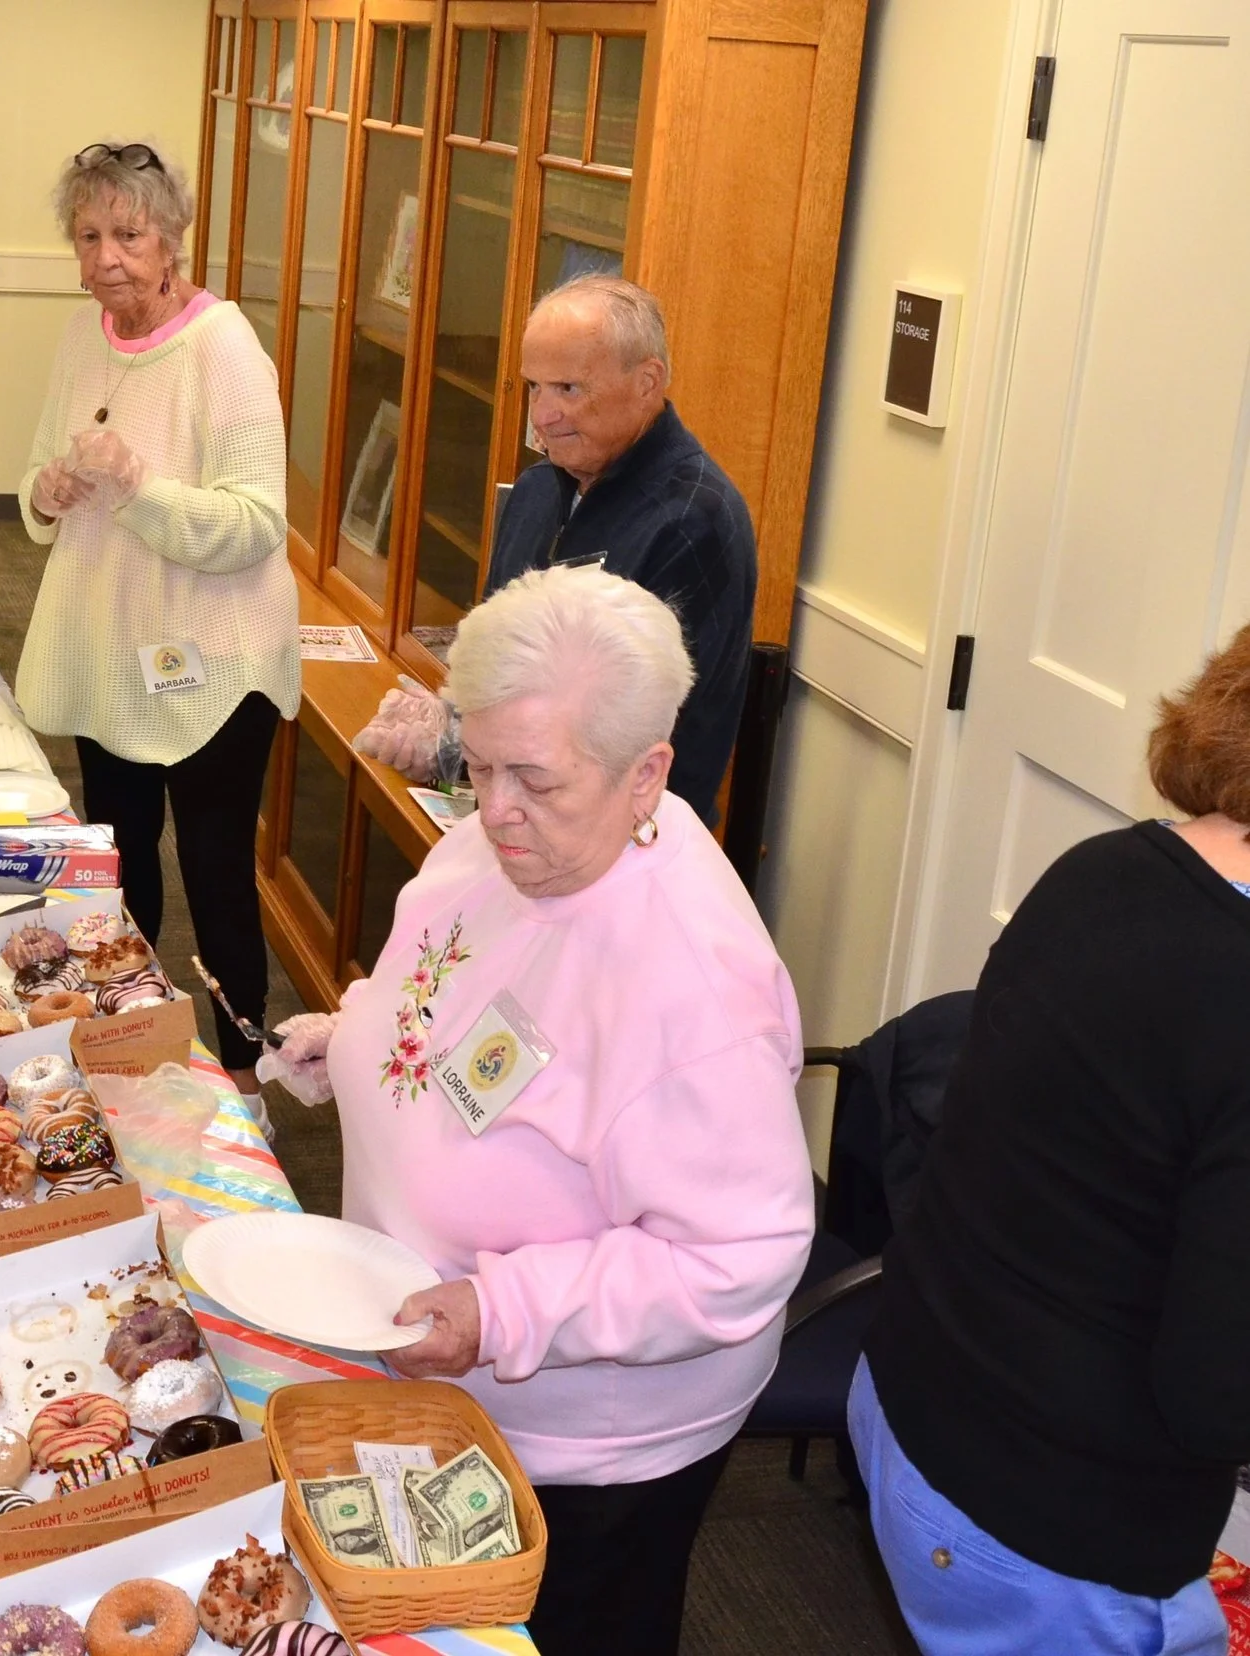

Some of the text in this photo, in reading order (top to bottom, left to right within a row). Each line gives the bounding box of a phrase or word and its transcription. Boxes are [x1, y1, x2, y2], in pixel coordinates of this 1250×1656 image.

[898, 300, 912, 314] 114
[896, 321, 930, 341] STORAGE
[154, 677, 197, 690] BARBARA
[75, 870, 92, 881] 50
[101, 1028, 120, 1039] WITH
[122, 1018, 154, 1034] DONUTS!
[442, 1066, 485, 1123] LORRAINE
[7, 1224, 46, 1239] MICROWAVE
[48, 1221, 60, 1230] FOR
[29, 1467, 210, 1529] EVENT is sweeter WITH DONUTS!
[102, 1511, 122, 1520] TODAY
[124, 1506, 136, 1514] FOR
[170, 1488, 197, 1500] OPTIONS
[4, 1552, 19, 1560] FOR
[22, 1547, 69, 1559] MICROWAVE
